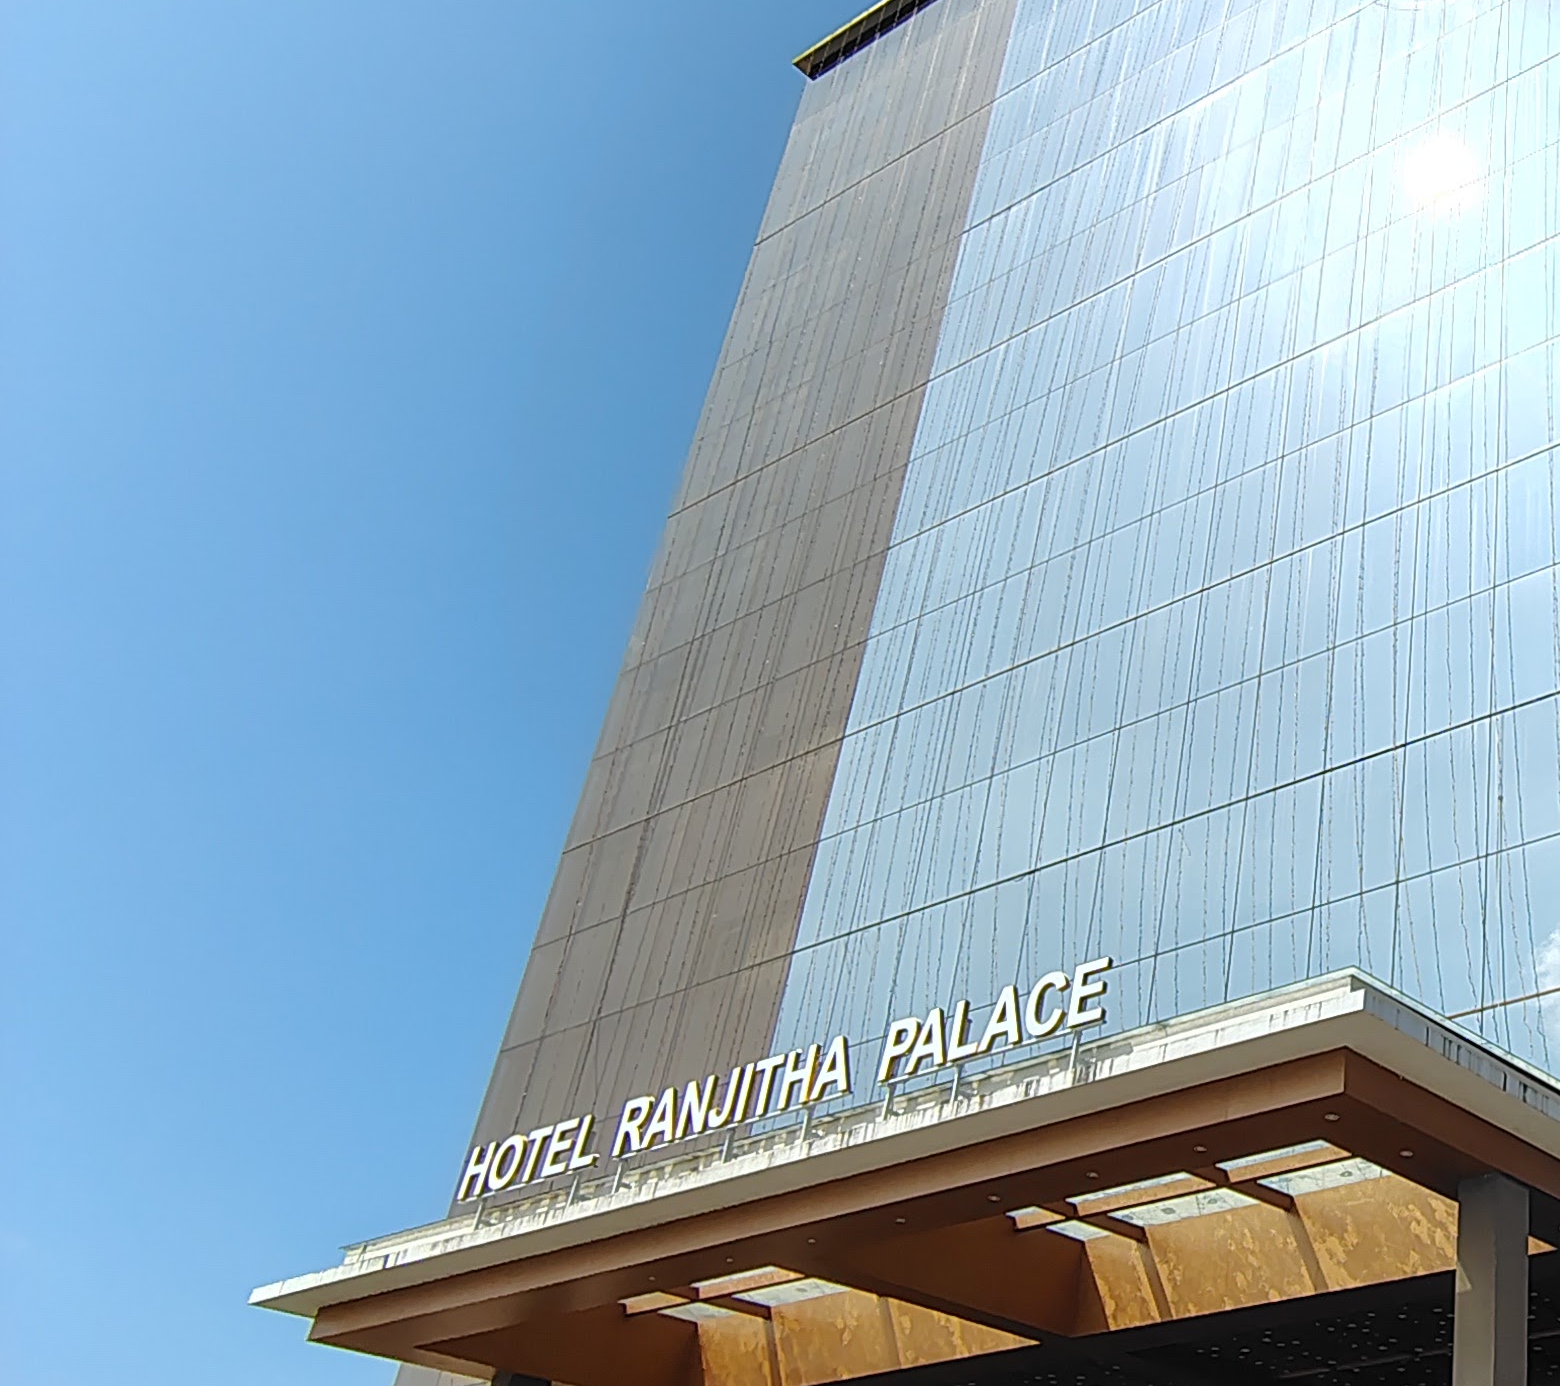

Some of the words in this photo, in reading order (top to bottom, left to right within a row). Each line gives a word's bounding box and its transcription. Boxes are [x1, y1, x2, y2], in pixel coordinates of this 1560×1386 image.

[456, 1113, 600, 1201] HOTEL
[611, 1034, 852, 1158] RANJITHA
[877, 956, 1114, 1085] PALACE
